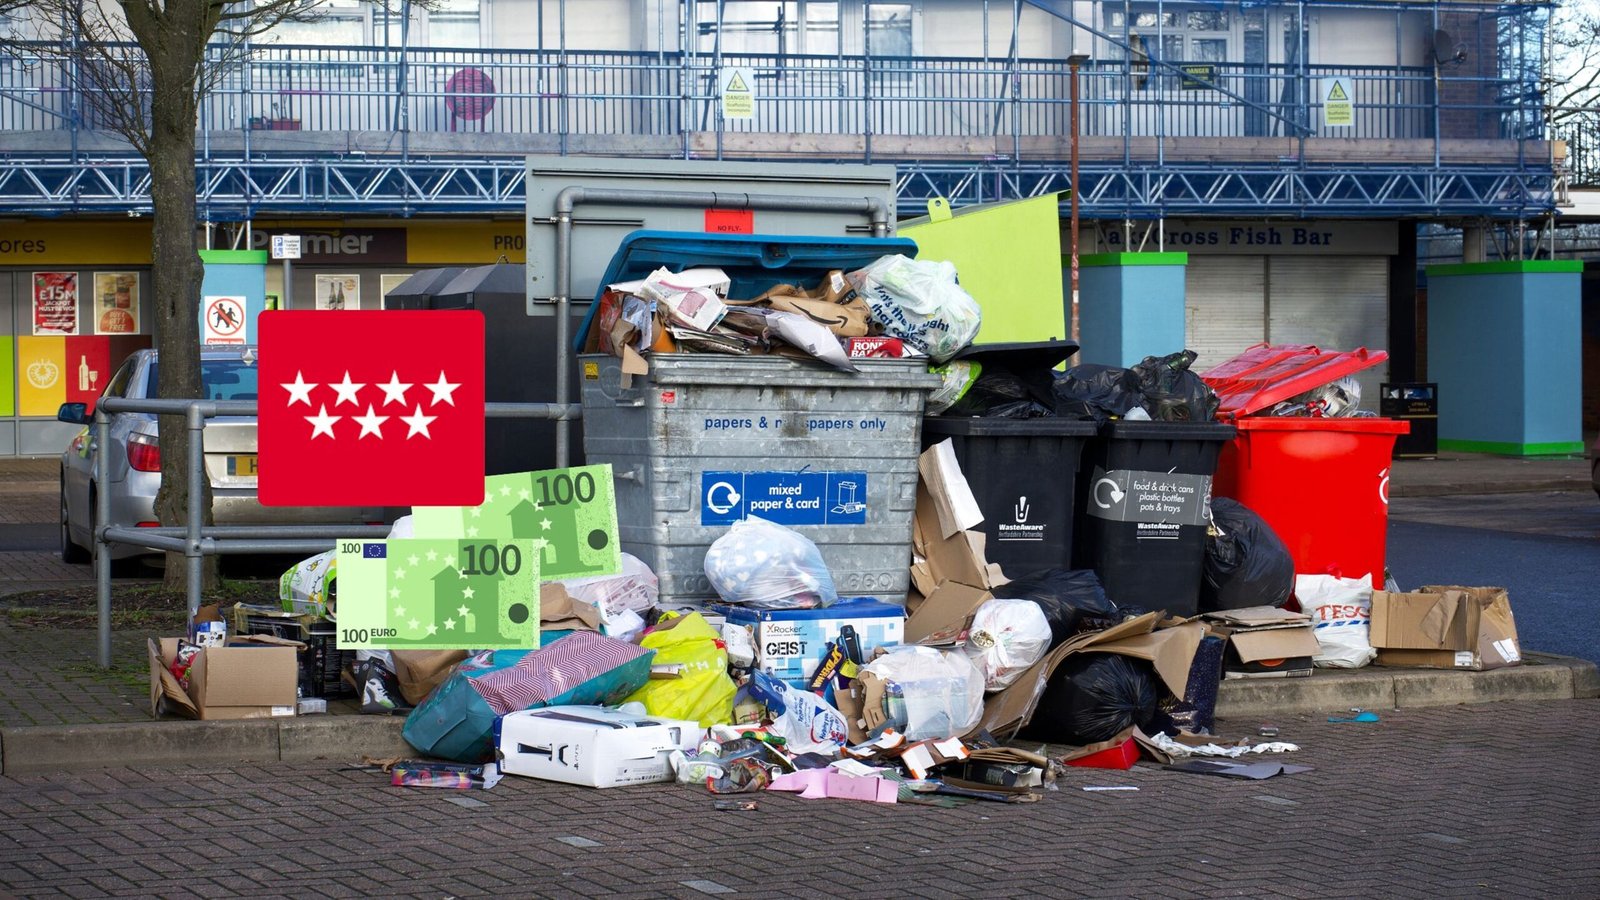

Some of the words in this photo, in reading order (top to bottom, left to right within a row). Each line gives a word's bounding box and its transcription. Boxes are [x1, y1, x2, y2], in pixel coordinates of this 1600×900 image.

[251, 230, 373, 254] Pmier
[494, 235, 526, 250] PRO
[1151, 228, 1218, 245] Cross
[1229, 228, 1282, 245] Fish
[1292, 229, 1332, 246] Bar
[40, 285, 75, 300] £15M
[871, 304, 893, 325] that
[705, 416, 752, 430] papers
[758, 416, 768, 428] &
[775, 417, 854, 431] nspapers
[860, 417, 886, 431] only
[769, 484, 801, 496] mixed
[1133, 481, 1150, 491] food
[1152, 482, 1157, 491] &
[1178, 485, 1194, 494] cans
[750, 501, 783, 513] paper
[785, 498, 794, 510] &
[796, 498, 819, 510] card
[1138, 493, 1160, 503] plastic
[1161, 495, 1185, 503] bottles
[1140, 503, 1155, 513] pots
[1163, 505, 1181, 515] trays
[1316, 604, 1371, 620] TESC
[767, 624, 803, 633] XRocker
[766, 641, 807, 655] GEIST
